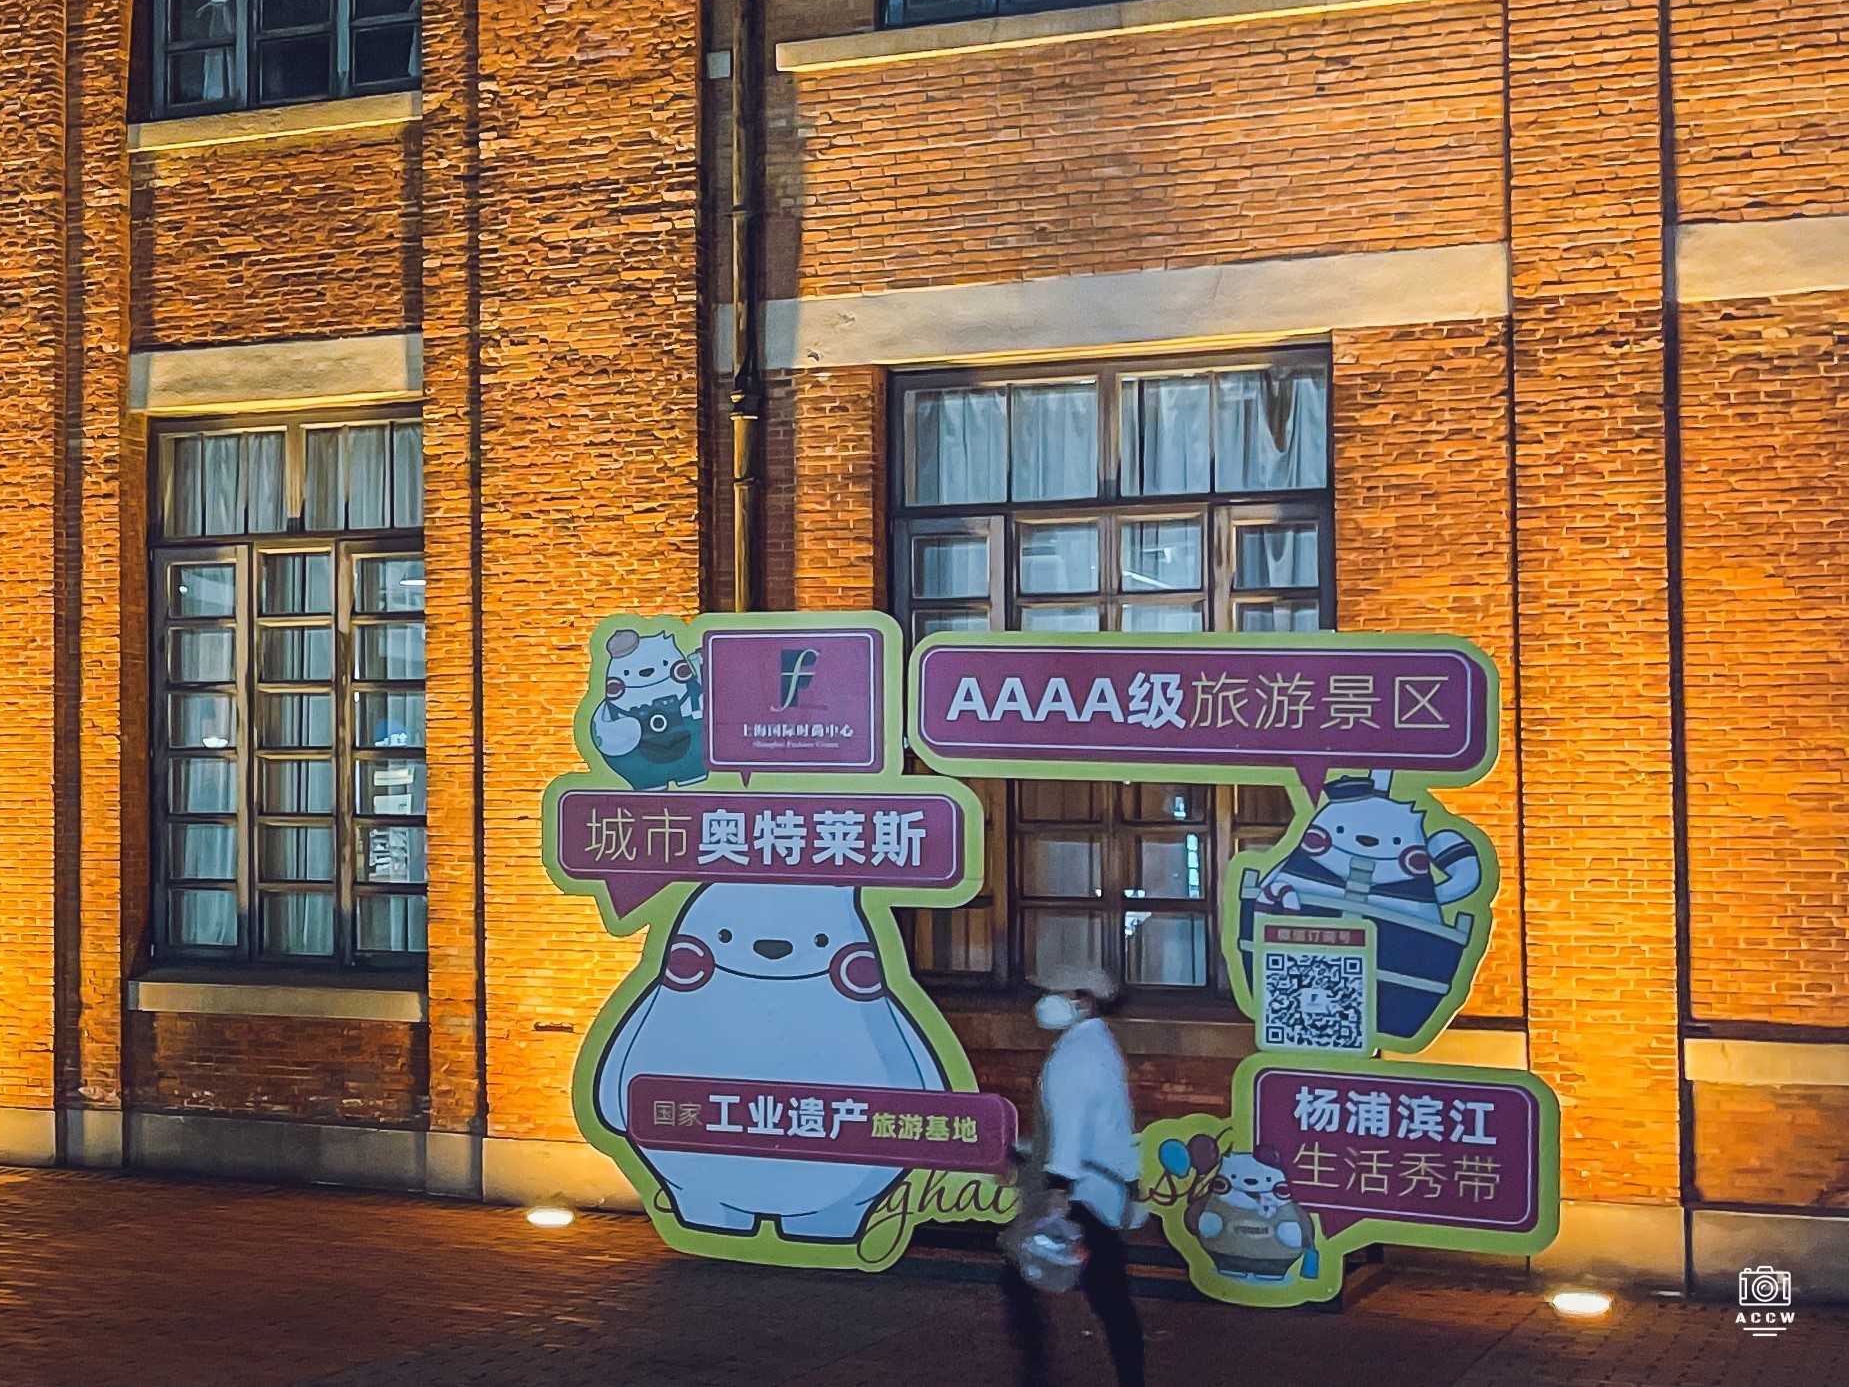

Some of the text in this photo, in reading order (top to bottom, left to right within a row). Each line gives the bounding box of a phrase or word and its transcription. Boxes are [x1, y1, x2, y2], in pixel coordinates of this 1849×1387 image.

[946, 671, 1451, 731] AAAA级旅游景区
[585, 807, 927, 868] 城市奥特莱斯
[1294, 1086, 1497, 1145] 杨浦滨江
[1292, 1142, 1501, 1203] 生活秀带
